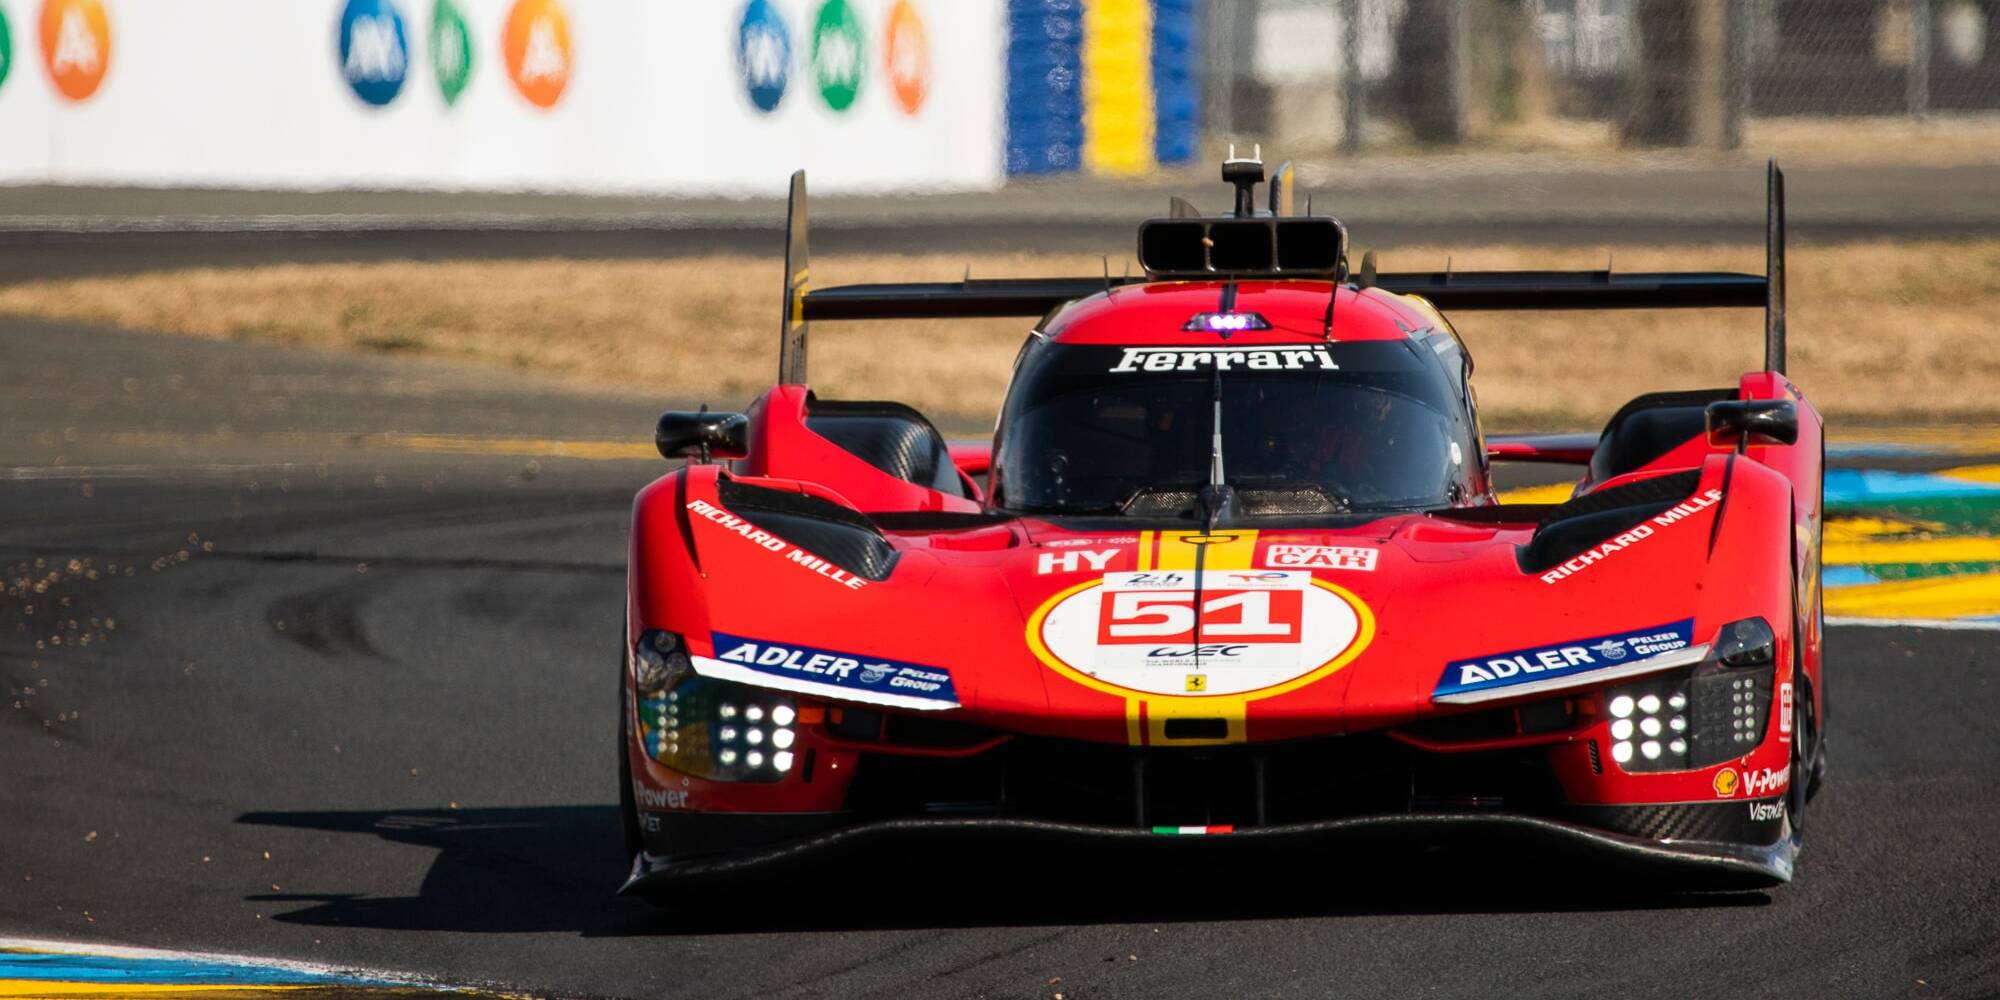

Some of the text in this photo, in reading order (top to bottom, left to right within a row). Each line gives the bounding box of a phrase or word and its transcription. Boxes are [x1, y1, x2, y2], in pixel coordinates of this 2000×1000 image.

[1109, 345, 1340, 372] Ferrari
[686, 499, 867, 590] RICHARD MILLE
[1540, 488, 1723, 585] RICHARD MILLE
[1037, 548, 1121, 575] HY
[1273, 553, 1367, 568] CAR
[1274, 547, 1370, 557] HYPER
[1110, 591, 1291, 636] 51
[1627, 632, 1679, 646] PELZER
[1634, 640, 1686, 655] GROUP
[719, 643, 859, 678] ADLER
[1459, 646, 1596, 685] ADLER
[889, 676, 941, 692] GROUP
[898, 667, 950, 682] PELZER
